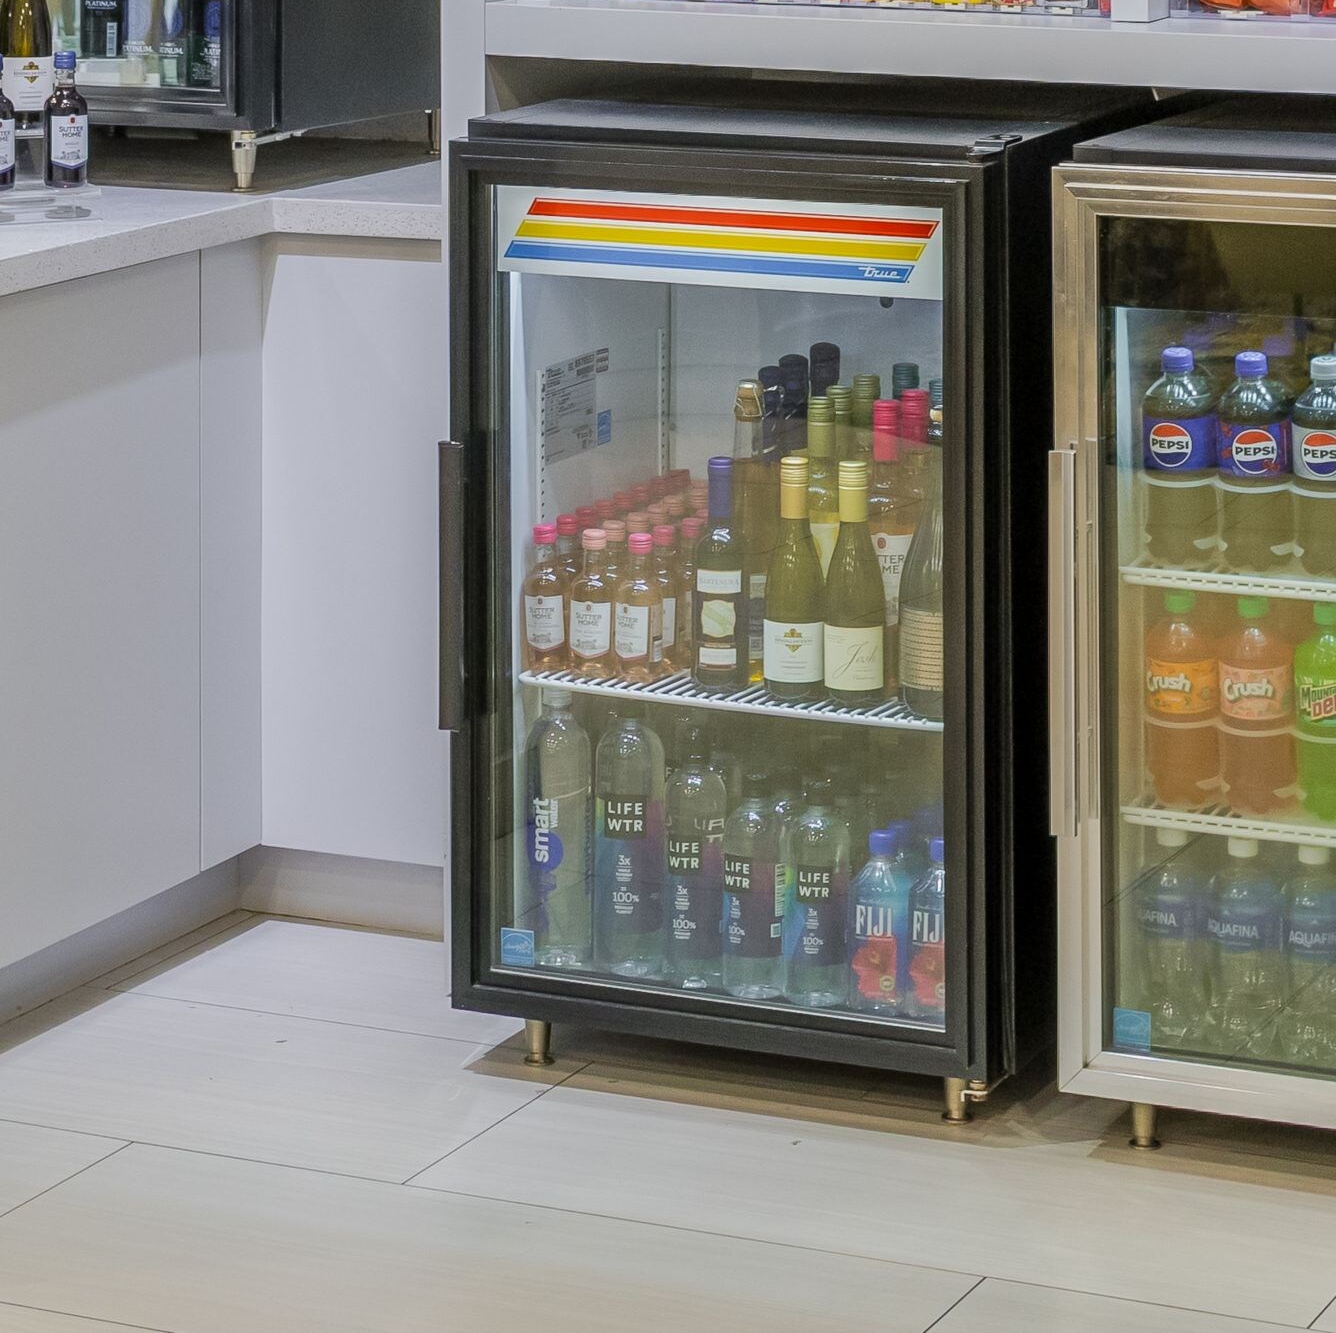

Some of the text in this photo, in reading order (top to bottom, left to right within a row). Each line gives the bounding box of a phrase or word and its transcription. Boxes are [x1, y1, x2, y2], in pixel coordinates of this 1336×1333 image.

[1152, 439, 1190, 450] PEPSI
[1235, 446, 1275, 457] PEPSI
[1147, 671, 1192, 692] Crush
[1224, 678, 1274, 700] Crush
[550, 799, 559, 828] water
[608, 801, 643, 815] LIFE
[533, 797, 549, 863] smart
[607, 817, 643, 832] WTR
[669, 840, 700, 854] LIFE
[618, 854, 631, 865] 3x
[669, 855, 700, 869] WTR
[725, 860, 750, 875] LIFE
[725, 874, 750, 889] WTR
[799, 871, 830, 884] LIFE
[677, 885, 688, 895] 3x
[799, 885, 830, 898] WTR
[612, 892, 640, 903] 100%
[808, 908, 818, 917] 3x
[673, 919, 697, 930] 100%
[856, 904, 893, 938] FIJI
[803, 936, 824, 946] 100%
